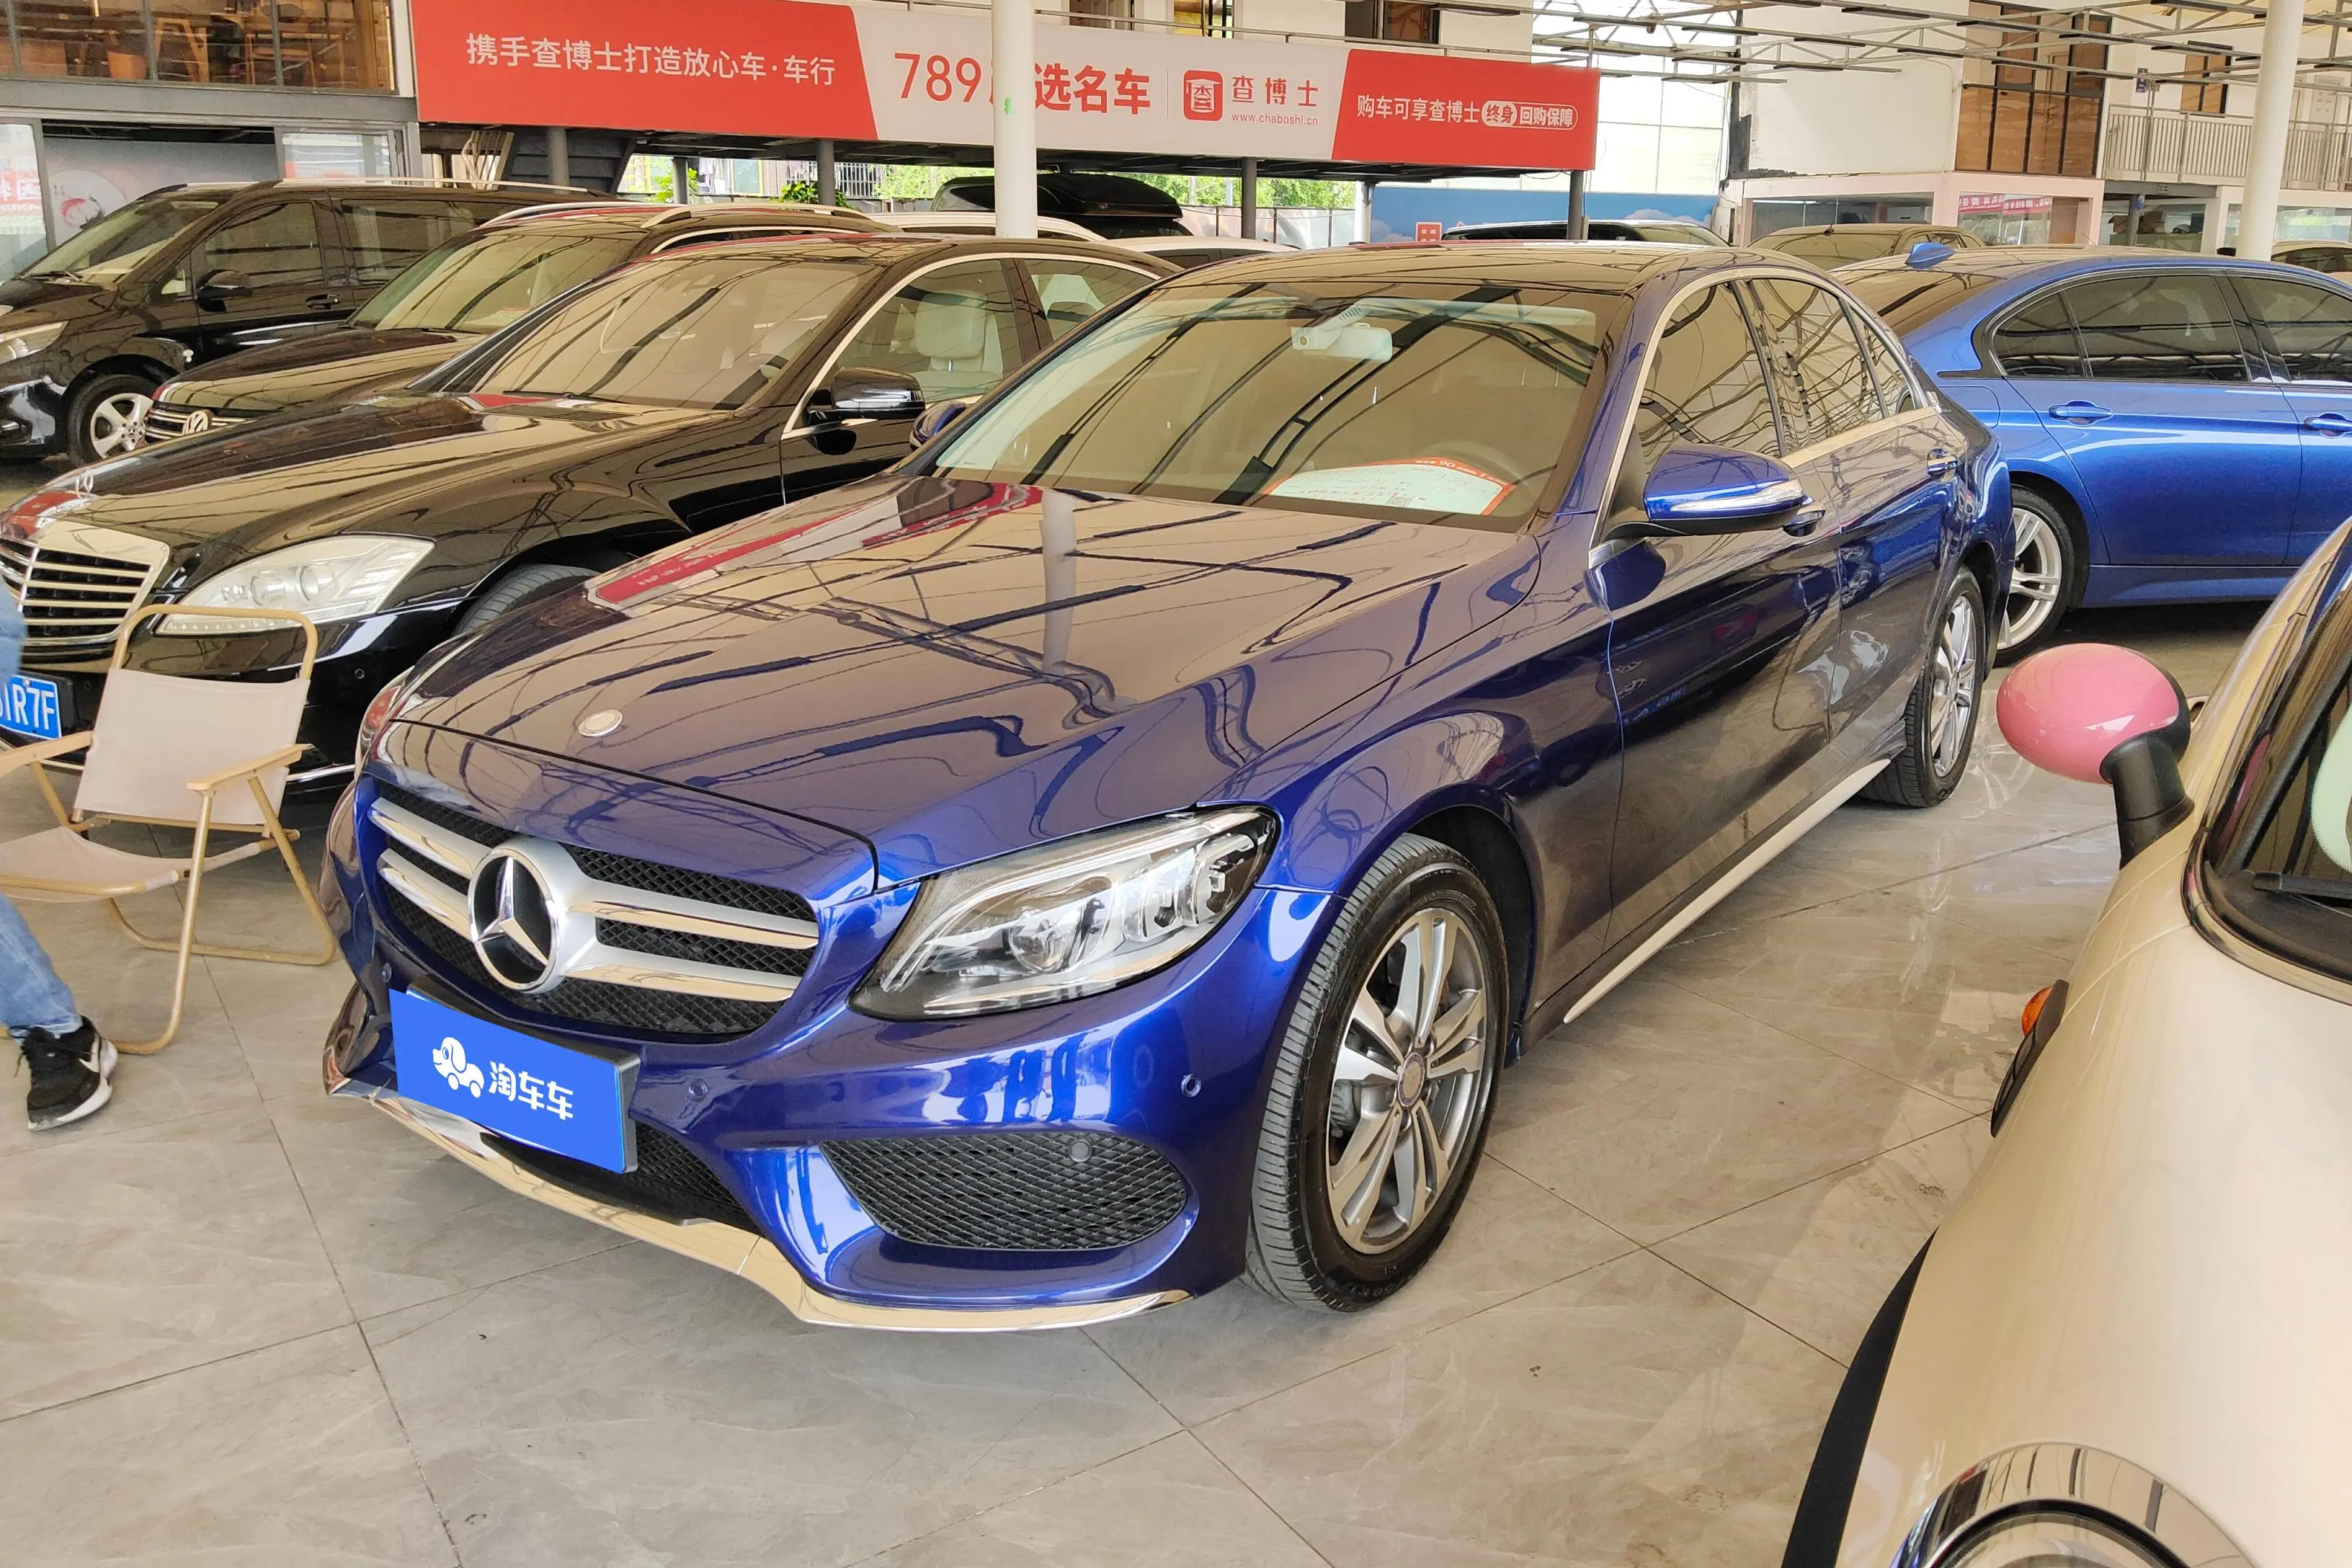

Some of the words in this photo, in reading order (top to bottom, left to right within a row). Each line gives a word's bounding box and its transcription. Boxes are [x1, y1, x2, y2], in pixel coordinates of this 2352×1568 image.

[466, 33, 835, 85] 携手查博士打造放心车·车行
[894, 52, 1151, 115] 789选名车
[1231, 76, 1318, 107] 查博士
[1231, 114, 1318, 125] www.chaboshi.cn
[0, 682, 55, 731] 1R7F
